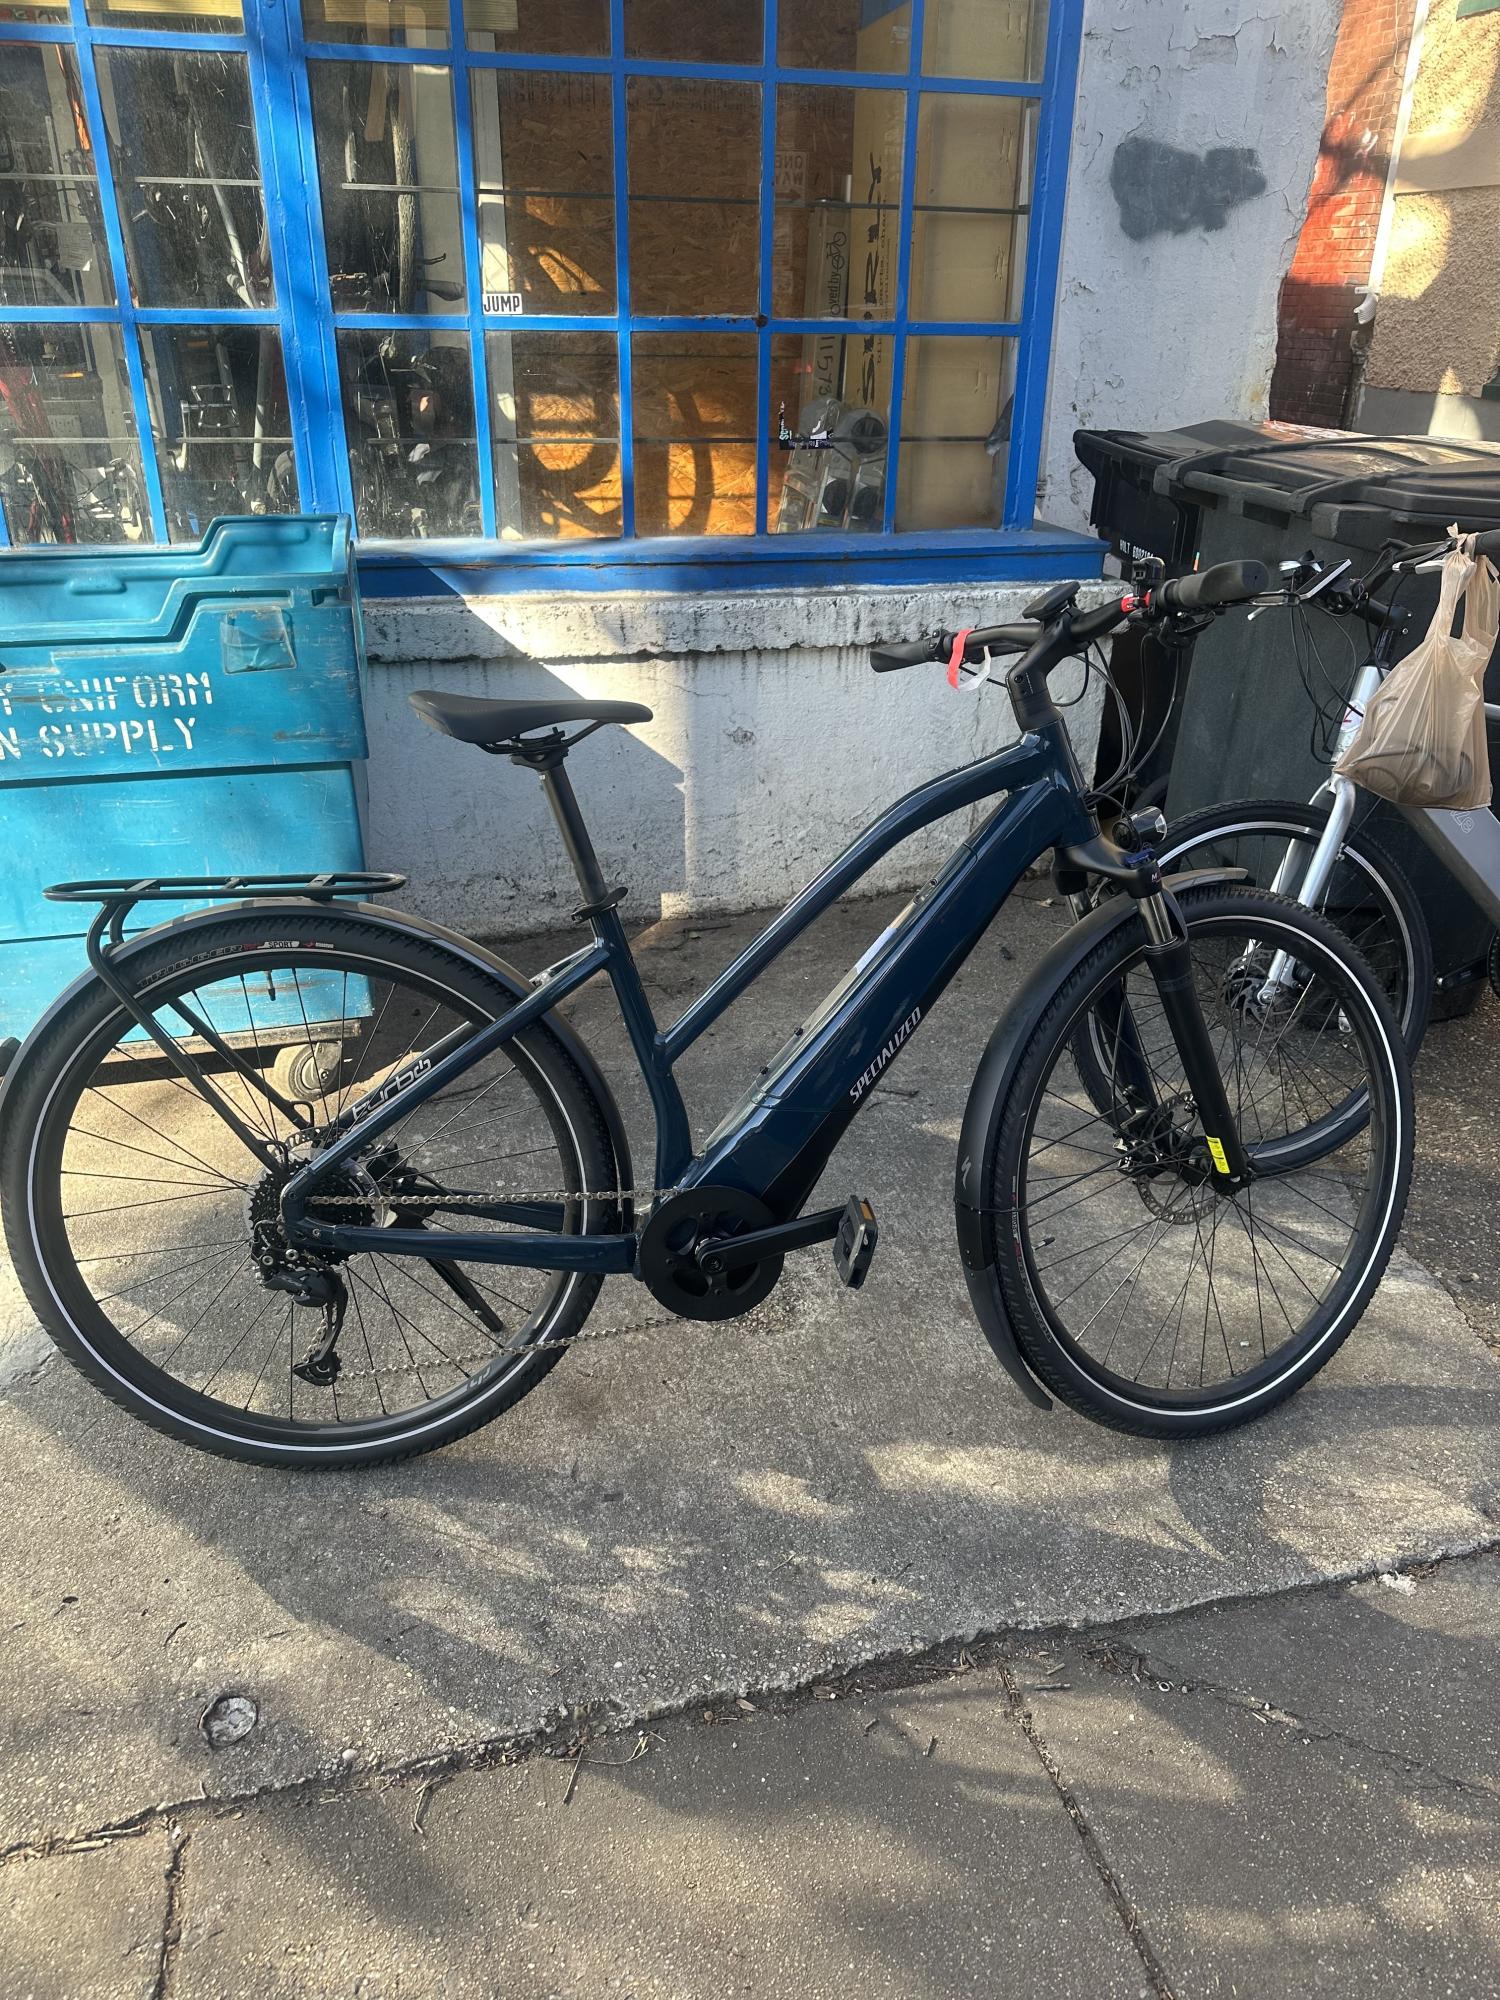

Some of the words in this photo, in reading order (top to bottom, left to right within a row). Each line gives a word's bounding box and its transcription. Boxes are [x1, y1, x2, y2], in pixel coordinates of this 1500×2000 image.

[484, 295, 520, 312] JUMP
[39, 717, 196, 758] SUPPLY
[267, 940, 294, 949] SPORT
[849, 1006, 921, 1105] SPECIALIZED
[351, 1058, 432, 1121] turbo
